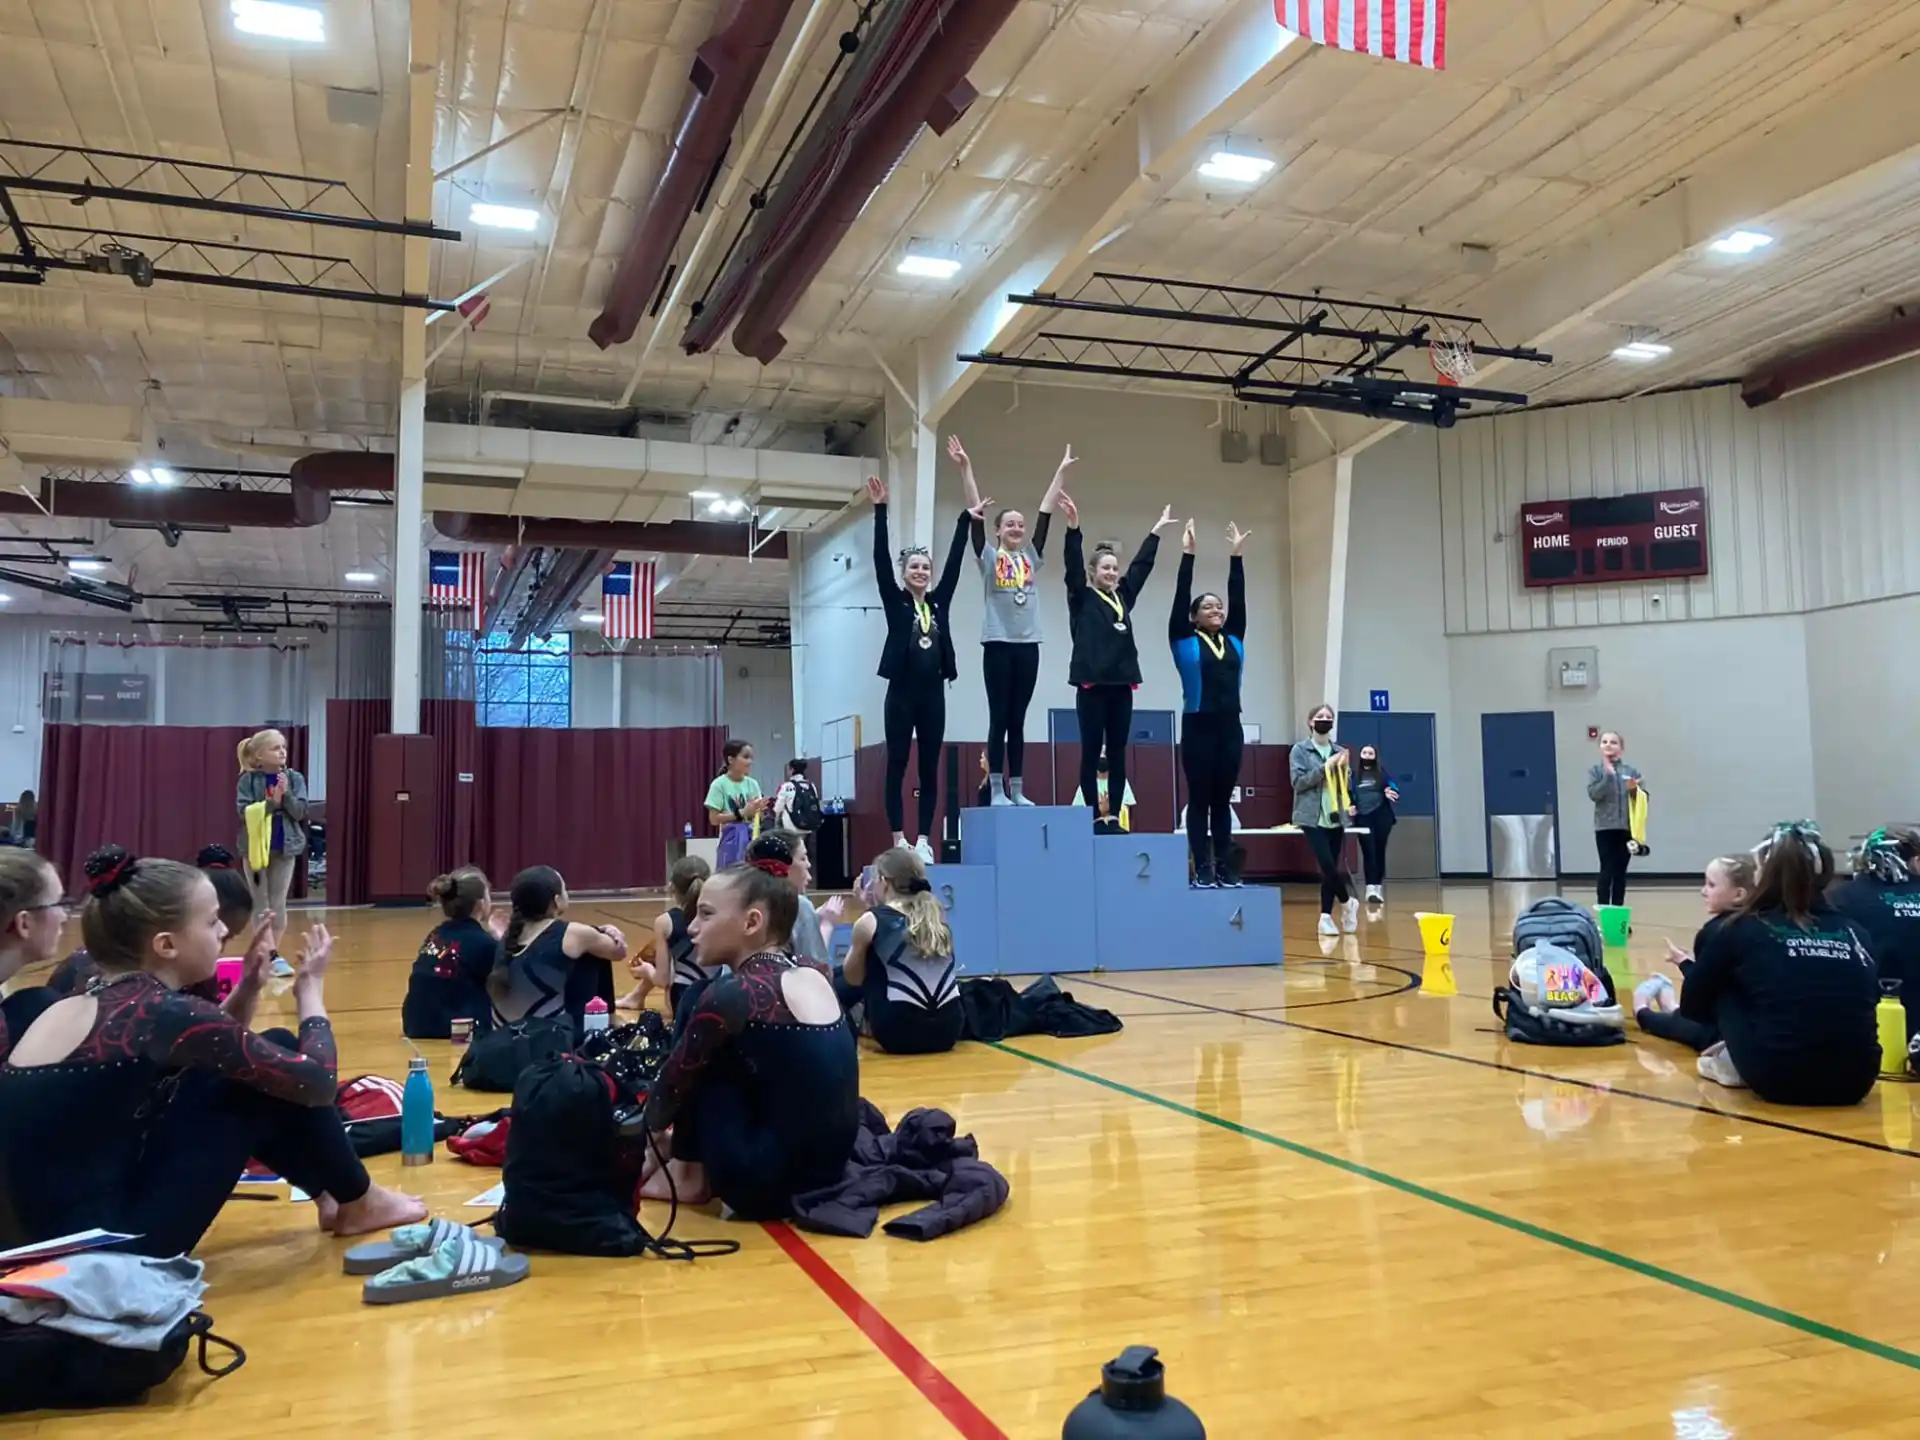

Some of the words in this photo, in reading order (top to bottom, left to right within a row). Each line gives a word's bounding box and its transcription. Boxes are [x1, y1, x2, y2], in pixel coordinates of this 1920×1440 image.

[1654, 524, 1698, 540] GUEST
[1533, 534, 1571, 549] HOME
[1597, 536, 1629, 547] PERIOD
[1374, 695, 1386, 707] 11
[1040, 824, 1049, 850] 1
[1136, 852, 1151, 879] 2
[940, 884, 955, 911] 3
[1230, 906, 1245, 931] 4
[1786, 938, 1851, 950] GYMNASTICS
[1788, 948, 1797, 957] &
[1799, 947, 1850, 960] TUMBLING
